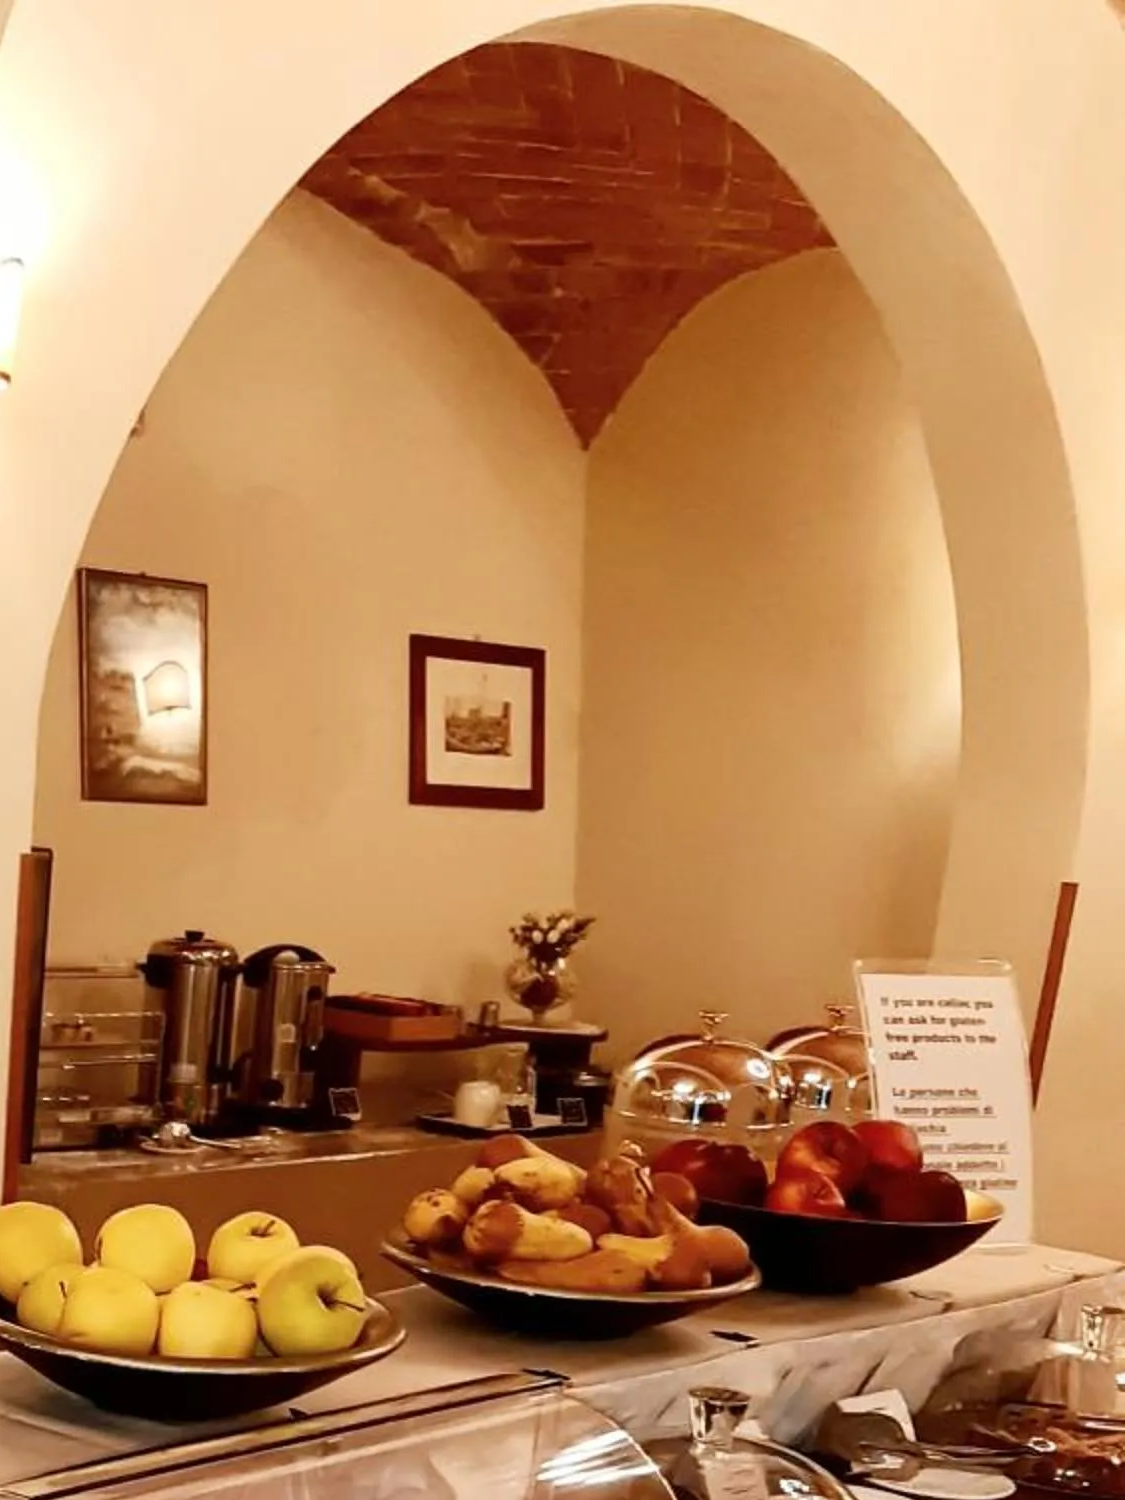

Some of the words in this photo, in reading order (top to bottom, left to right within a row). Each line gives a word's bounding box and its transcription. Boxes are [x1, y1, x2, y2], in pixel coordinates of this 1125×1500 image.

[893, 999, 914, 1009] you
[916, 999, 934, 1007] are
[974, 1000, 994, 1011] you
[882, 1016, 904, 1025] can
[908, 1015, 927, 1025] ask
[930, 1015, 946, 1025] for
[885, 1031, 909, 1042] free
[912, 1033, 962, 1044] products
[964, 1034, 976, 1043] to
[978, 1034, 997, 1043] the
[909, 1088, 955, 1099] persone
[958, 1087, 978, 1097] che
